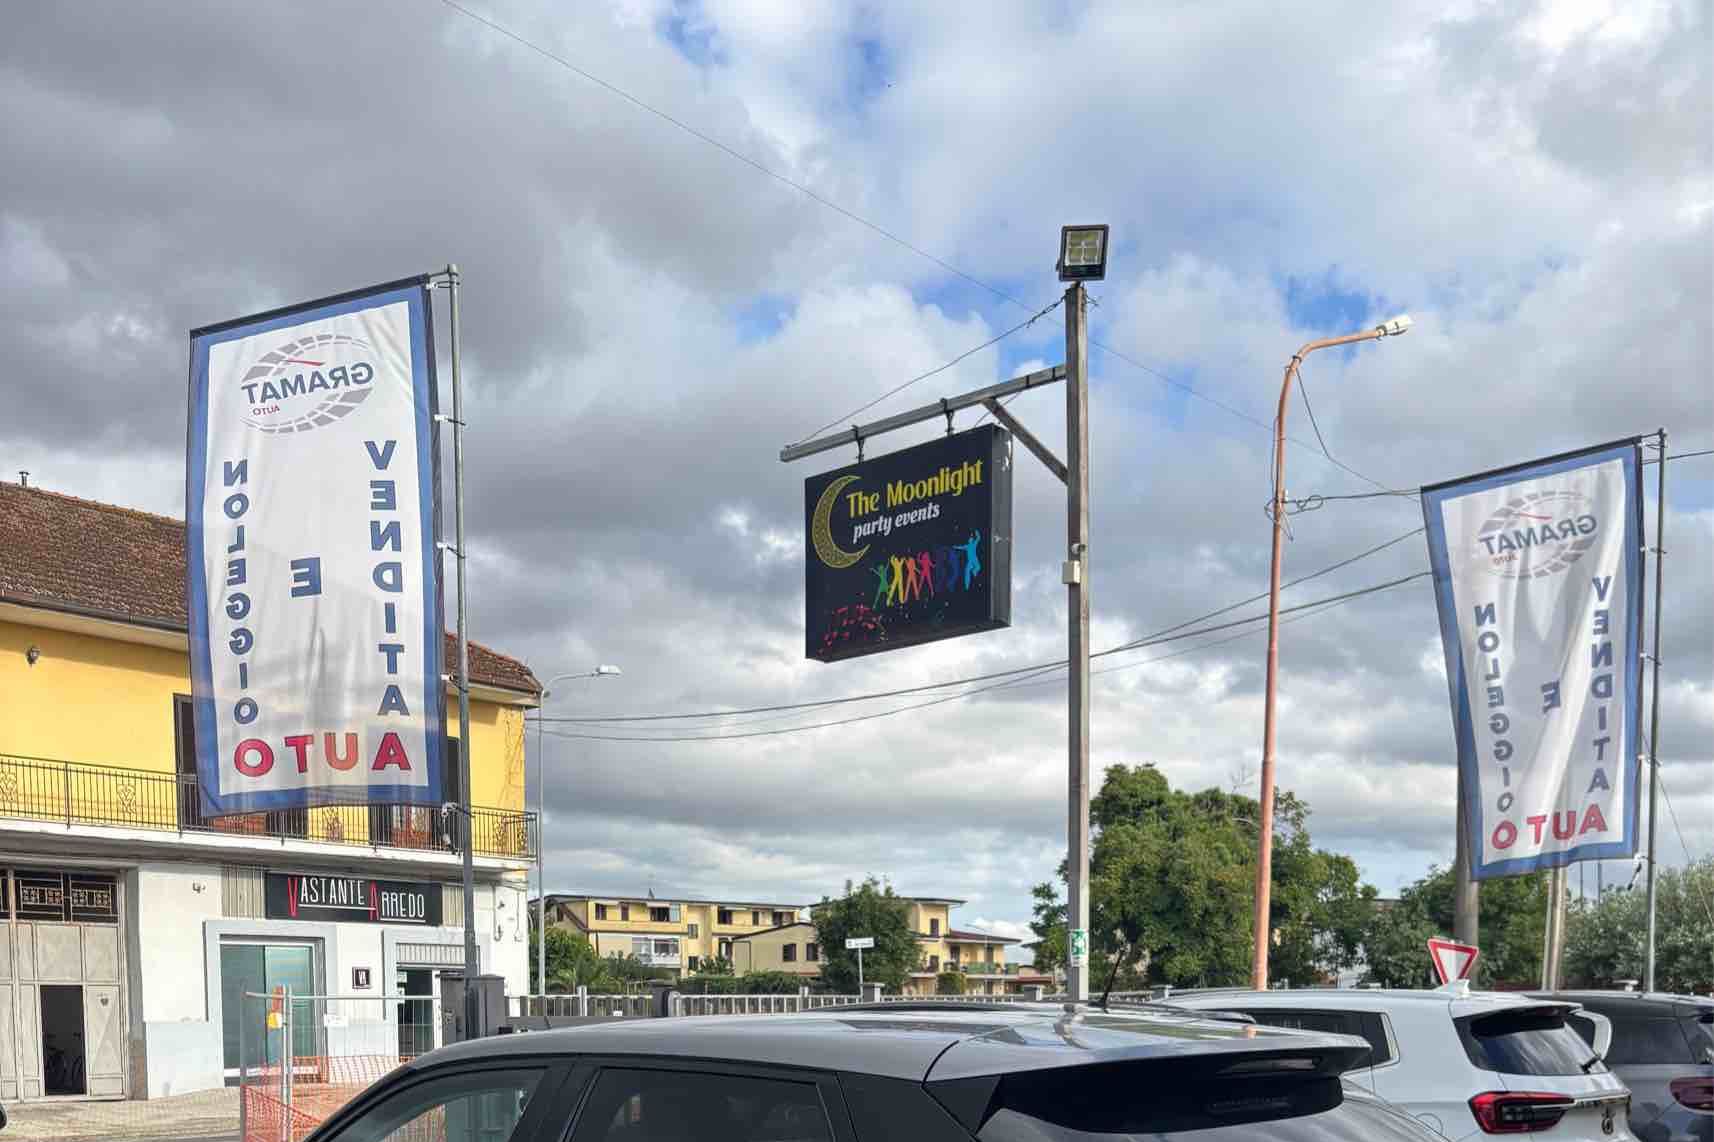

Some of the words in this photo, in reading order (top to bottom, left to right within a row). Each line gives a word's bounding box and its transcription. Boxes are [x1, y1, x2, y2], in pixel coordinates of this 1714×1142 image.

[846, 491, 880, 518] The
[886, 459, 983, 508] Moonlight
[853, 515, 892, 544] party
[895, 502, 940, 527] events
[288, 877, 366, 917] VASTANTE
[369, 880, 425, 920] ARREDO
